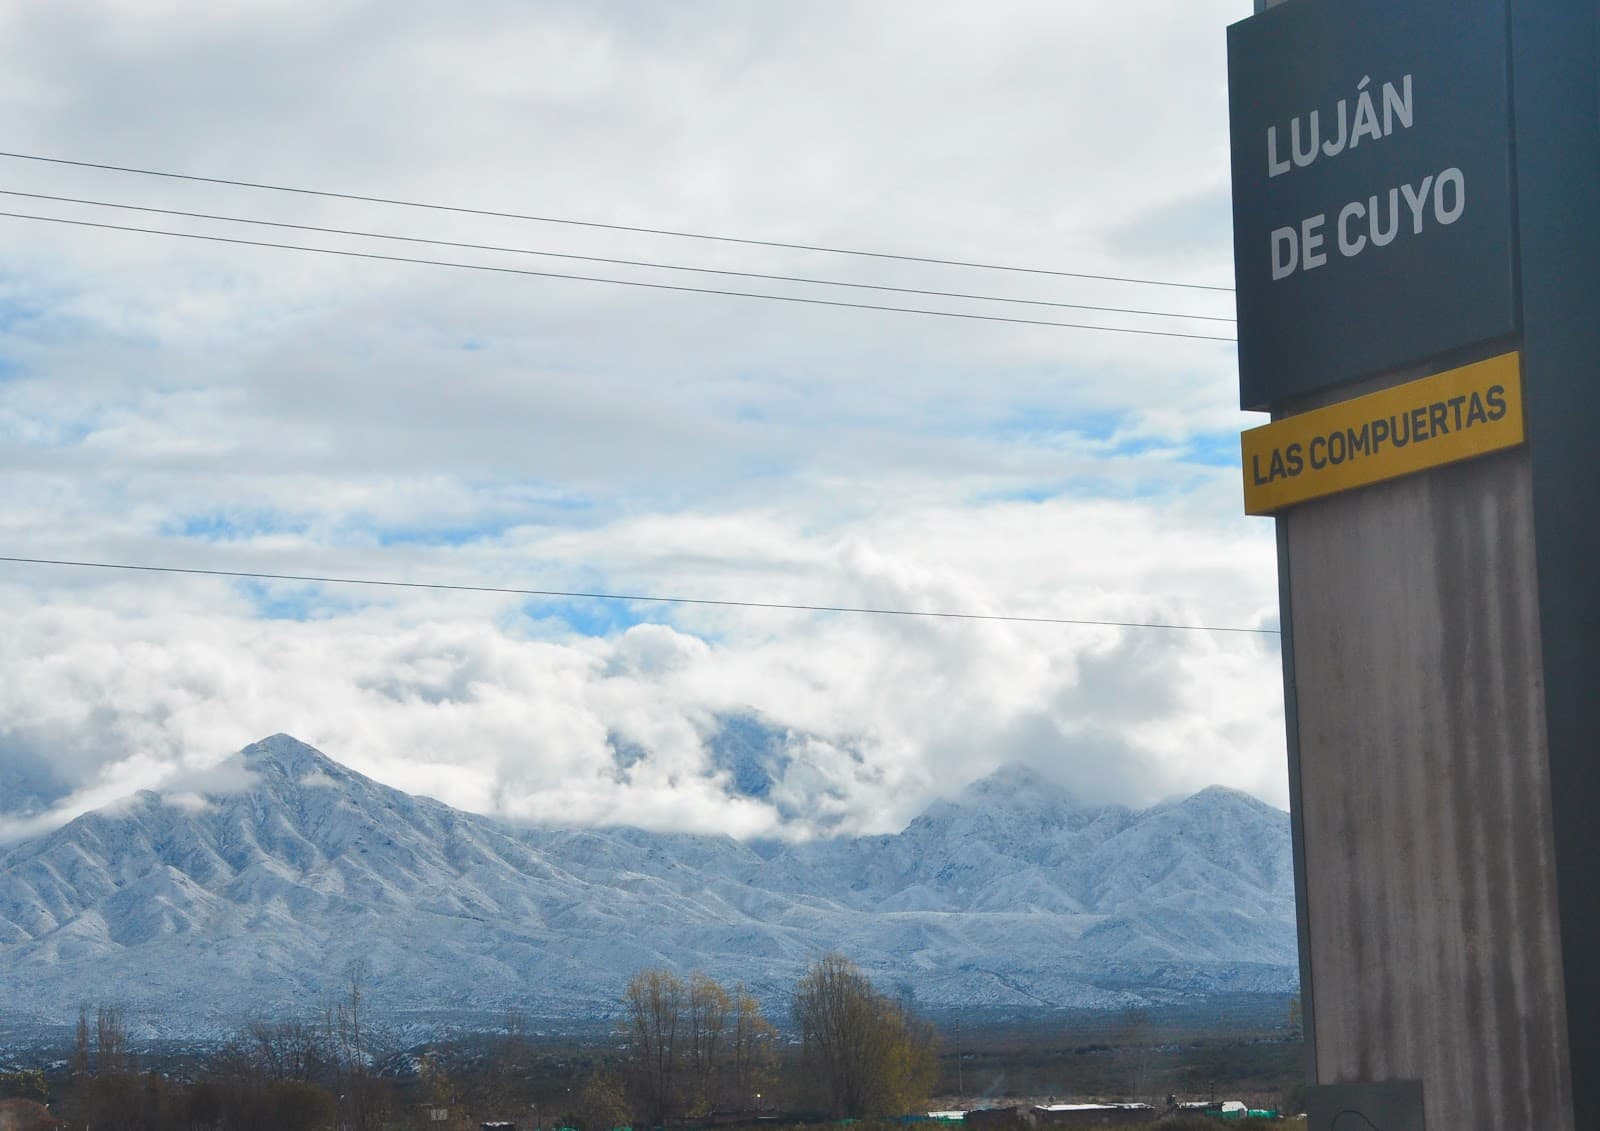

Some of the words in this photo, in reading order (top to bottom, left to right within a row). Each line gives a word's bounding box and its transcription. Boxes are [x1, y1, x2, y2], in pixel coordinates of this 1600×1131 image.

[1267, 75, 1413, 177] LUJÁN
[1271, 214, 1327, 280] DE
[1338, 167, 1465, 257] CUYO
[1253, 444, 1303, 486] LAS
[1310, 385, 1507, 470] COMPUERTAS
